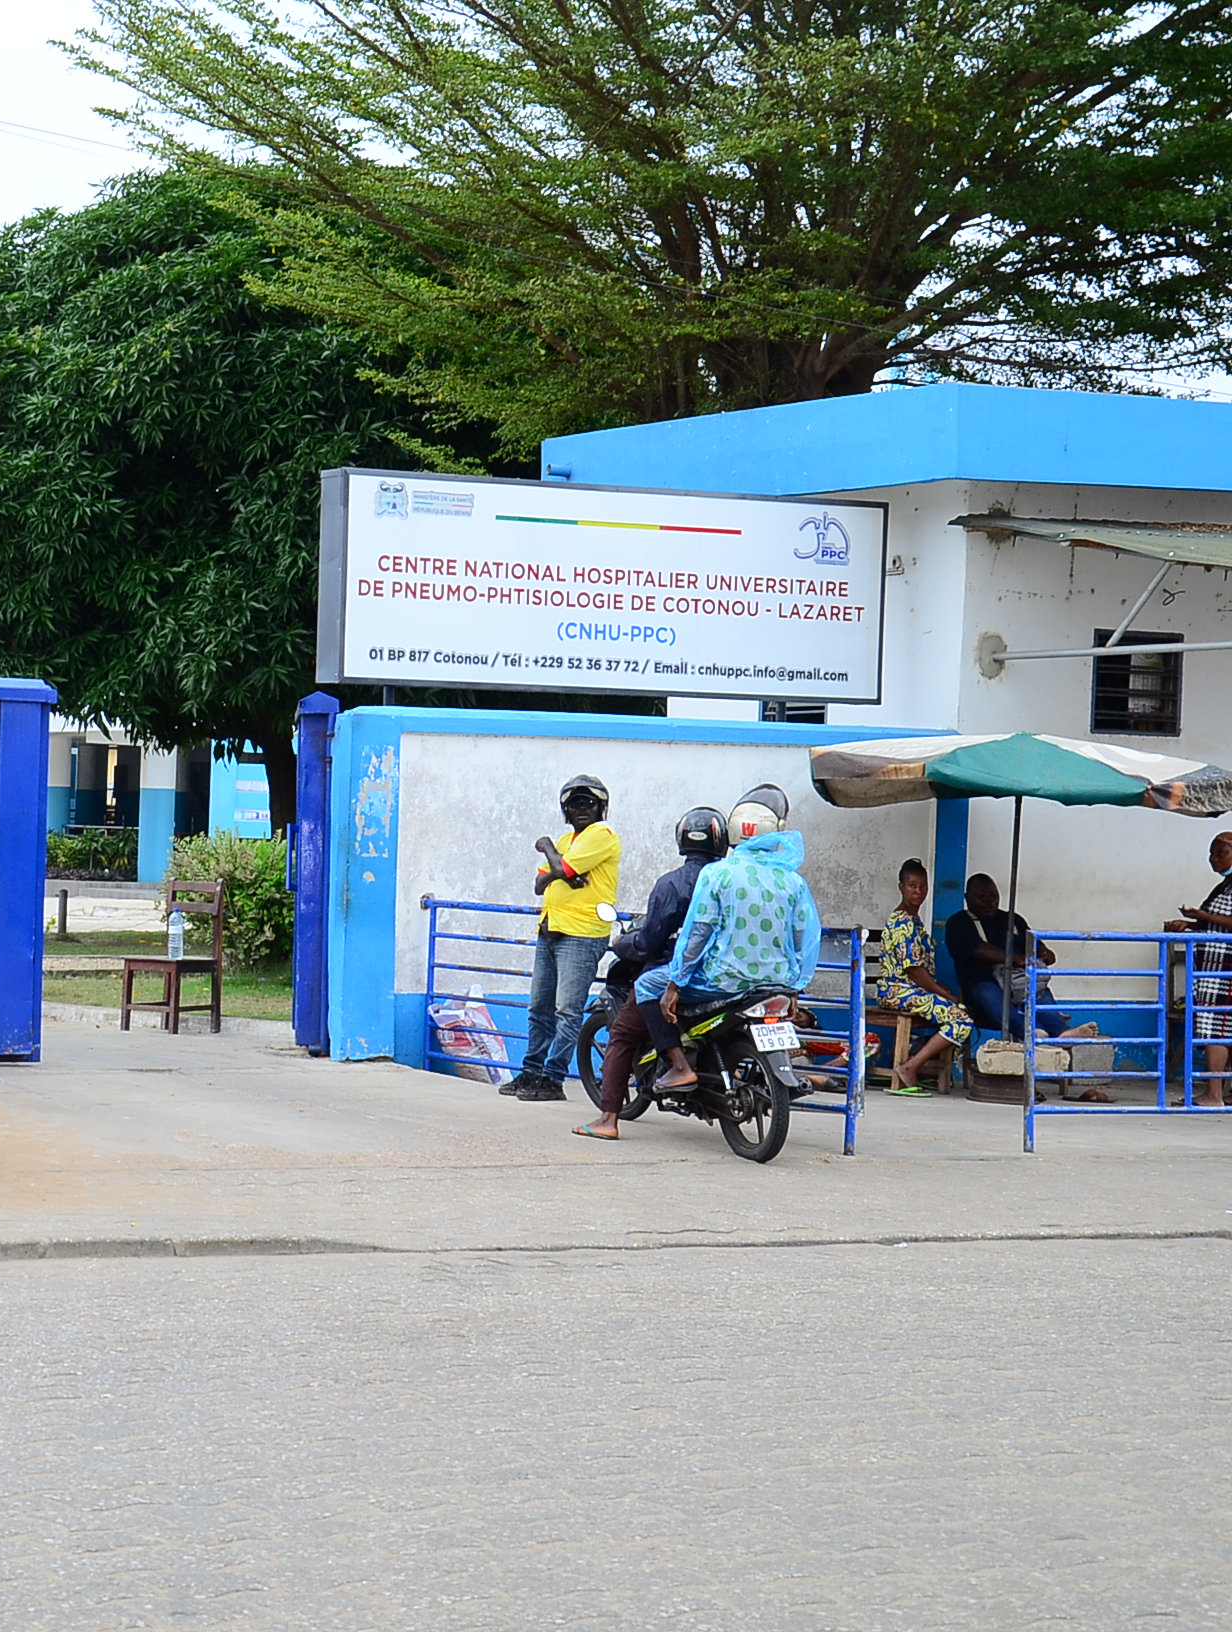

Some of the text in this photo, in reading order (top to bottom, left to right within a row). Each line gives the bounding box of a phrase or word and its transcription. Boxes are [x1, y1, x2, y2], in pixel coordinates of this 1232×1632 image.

[821, 550, 846, 560] PPC
[377, 554, 849, 598] CENTRE NATIONAL HOSPITALIER UNIVERSITAIRE
[358, 578, 385, 598] DE
[391, 581, 624, 611] PNEUMO-PHTISIOLOGIE
[630, 594, 656, 612] DE
[662, 596, 759, 617] COTONOU
[778, 602, 866, 623] LAZARET
[556, 621, 676, 647] (CNHU-PPC)
[368, 648, 384, 661] 01
[387, 648, 406, 662] BP
[408, 650, 430, 663] 817
[433, 651, 489, 665] Cotonou
[501, 652, 522, 668] Tél
[532, 656, 564, 669] +229
[567, 657, 583, 670] 52
[585, 658, 602, 671] 36
[605, 659, 621, 672] 37
[622, 659, 640, 673] 72
[653, 661, 688, 675] Email
[697, 663, 849, 683] cnhuppc.info@gmail.com
[759, 1035, 796, 1049] 1902
